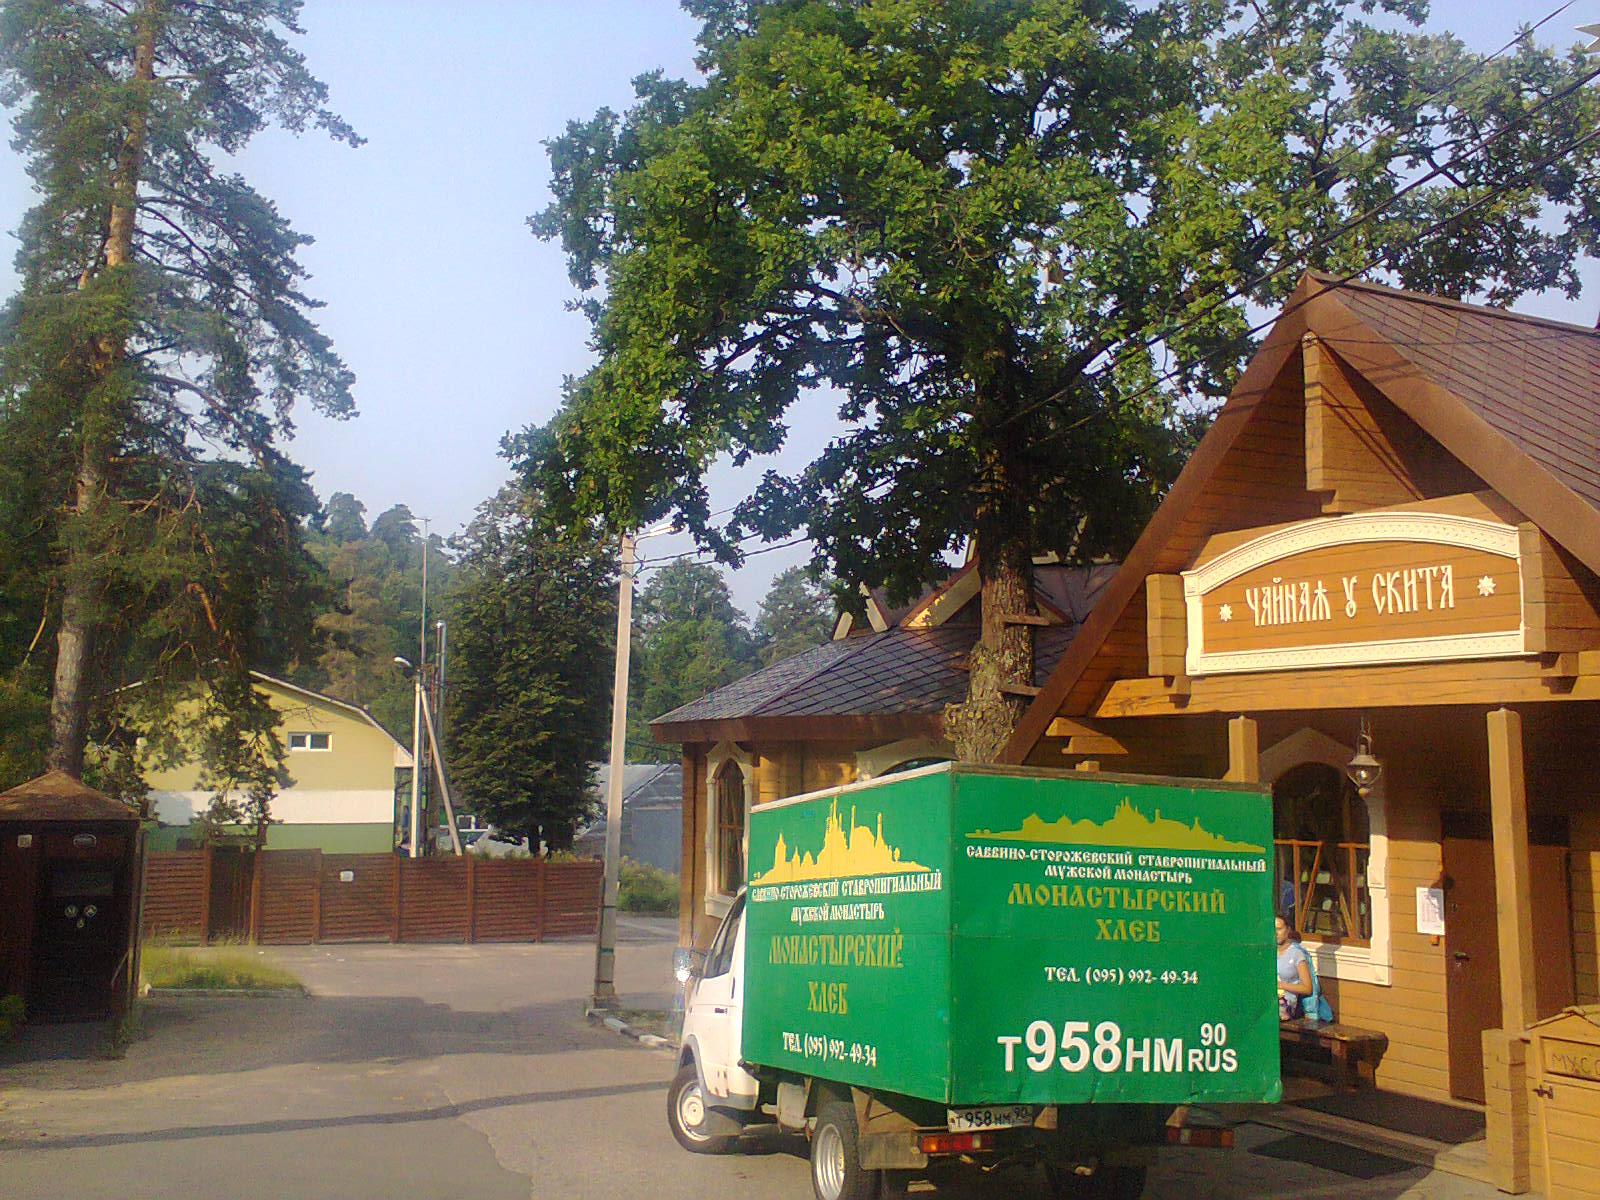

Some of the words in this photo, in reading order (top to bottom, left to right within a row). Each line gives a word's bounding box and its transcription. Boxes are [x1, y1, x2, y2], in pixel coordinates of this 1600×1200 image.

[1371, 564, 1456, 615] СКИТА
[965, 844, 1134, 865] САВВИНО-СТОРОЖЕВСКИЙ
[1138, 853, 1267, 873] СТАВРОПИГИАЛЬНЫЙ
[1044, 864, 1112, 881] МУЖСКОЙ
[1113, 867, 1193, 885] МОНАСТЫРЬ
[1007, 881, 1226, 914] МОНАСТЫРСКИЙ
[829, 902, 886, 921] МОНАСТЫРЬ
[1095, 918, 1161, 943] ХЛЕБ
[768, 927, 905, 968] МОНАСТЫРСКИЙ
[1043, 966, 1081, 983] ТЕЛ.
[1085, 966, 1125, 986] (095)
[807, 980, 848, 1015] ХЛЕБ
[803, 1032, 828, 1063] (095)
[1200, 1022, 1227, 1047] 90
[1187, 1048, 1239, 1073] RUS
